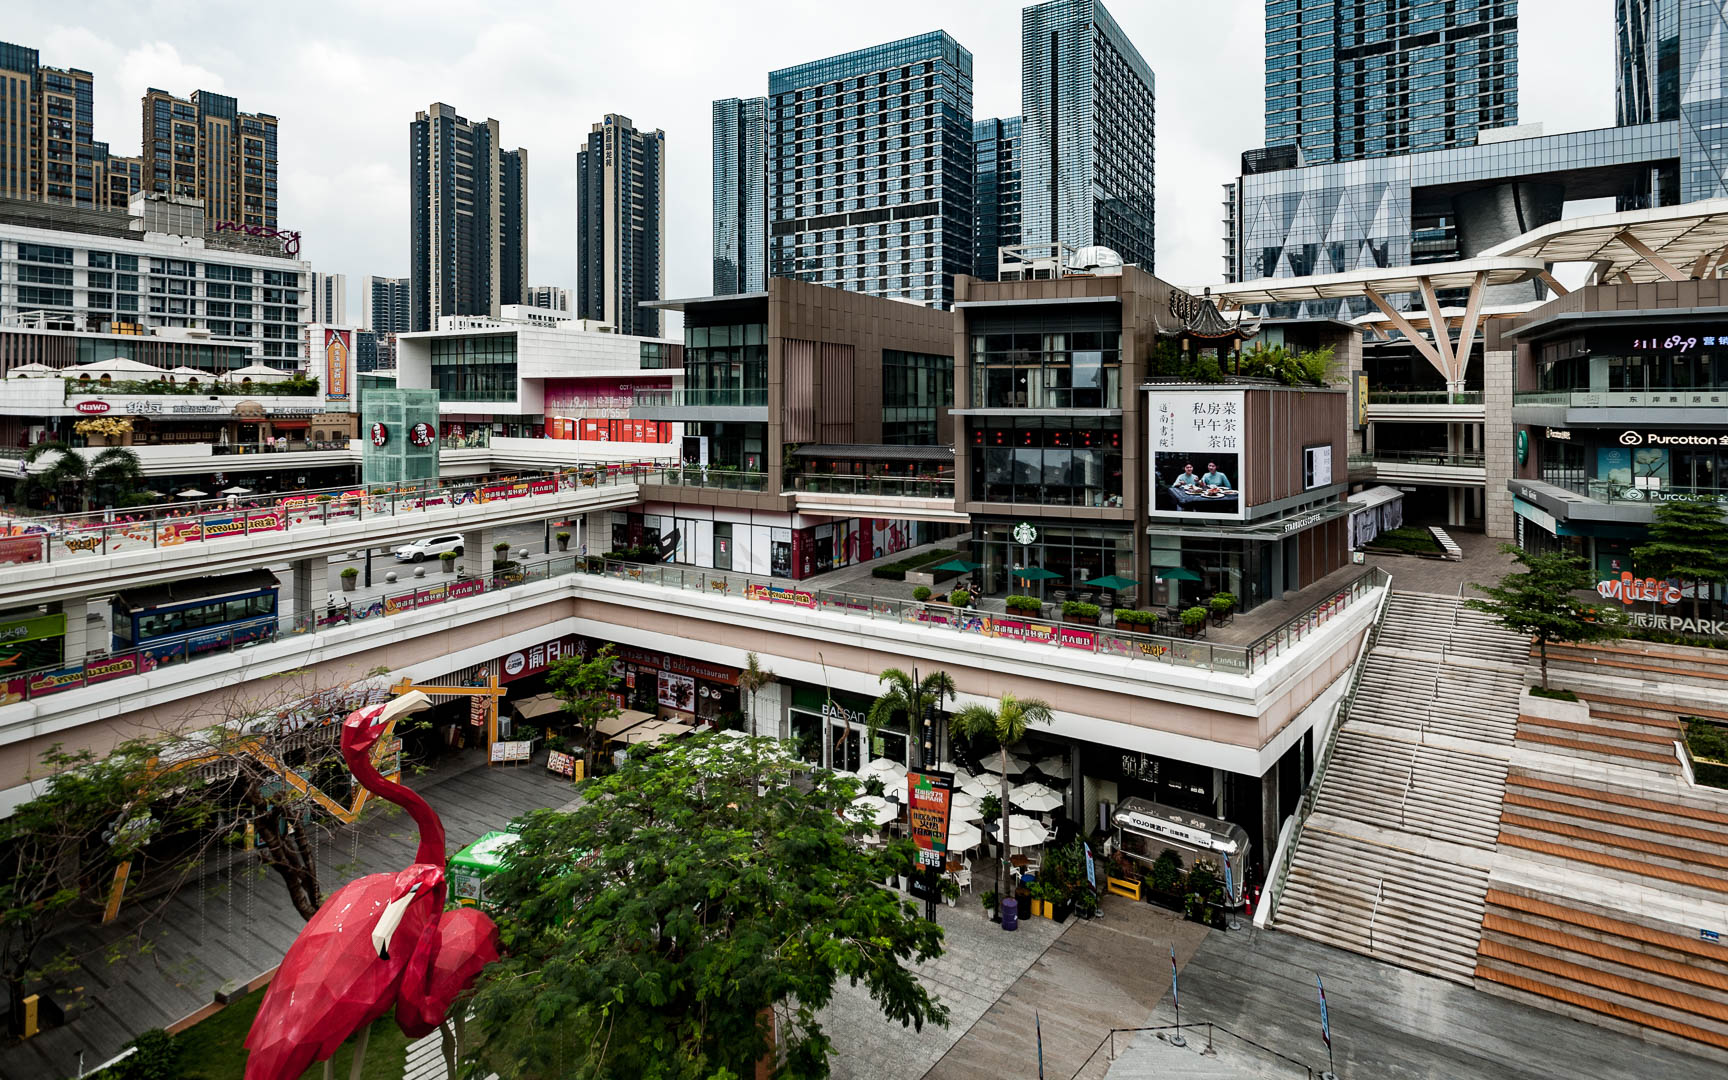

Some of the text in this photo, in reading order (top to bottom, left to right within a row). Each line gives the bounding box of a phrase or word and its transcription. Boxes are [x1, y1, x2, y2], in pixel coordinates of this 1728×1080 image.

[127, 400, 162, 414] 纳瓦
[1192, 402, 1236, 415] 私房菜
[1192, 418, 1236, 432] 早午茶
[1208, 435, 1236, 448] 茶馆
[1647, 433, 1717, 446] Purcotton
[1600, 580, 1681, 604] Music
[691, 664, 729, 680] Restaurant
[919, 850, 940, 860] 8989
[919, 858, 940, 867] 0919
